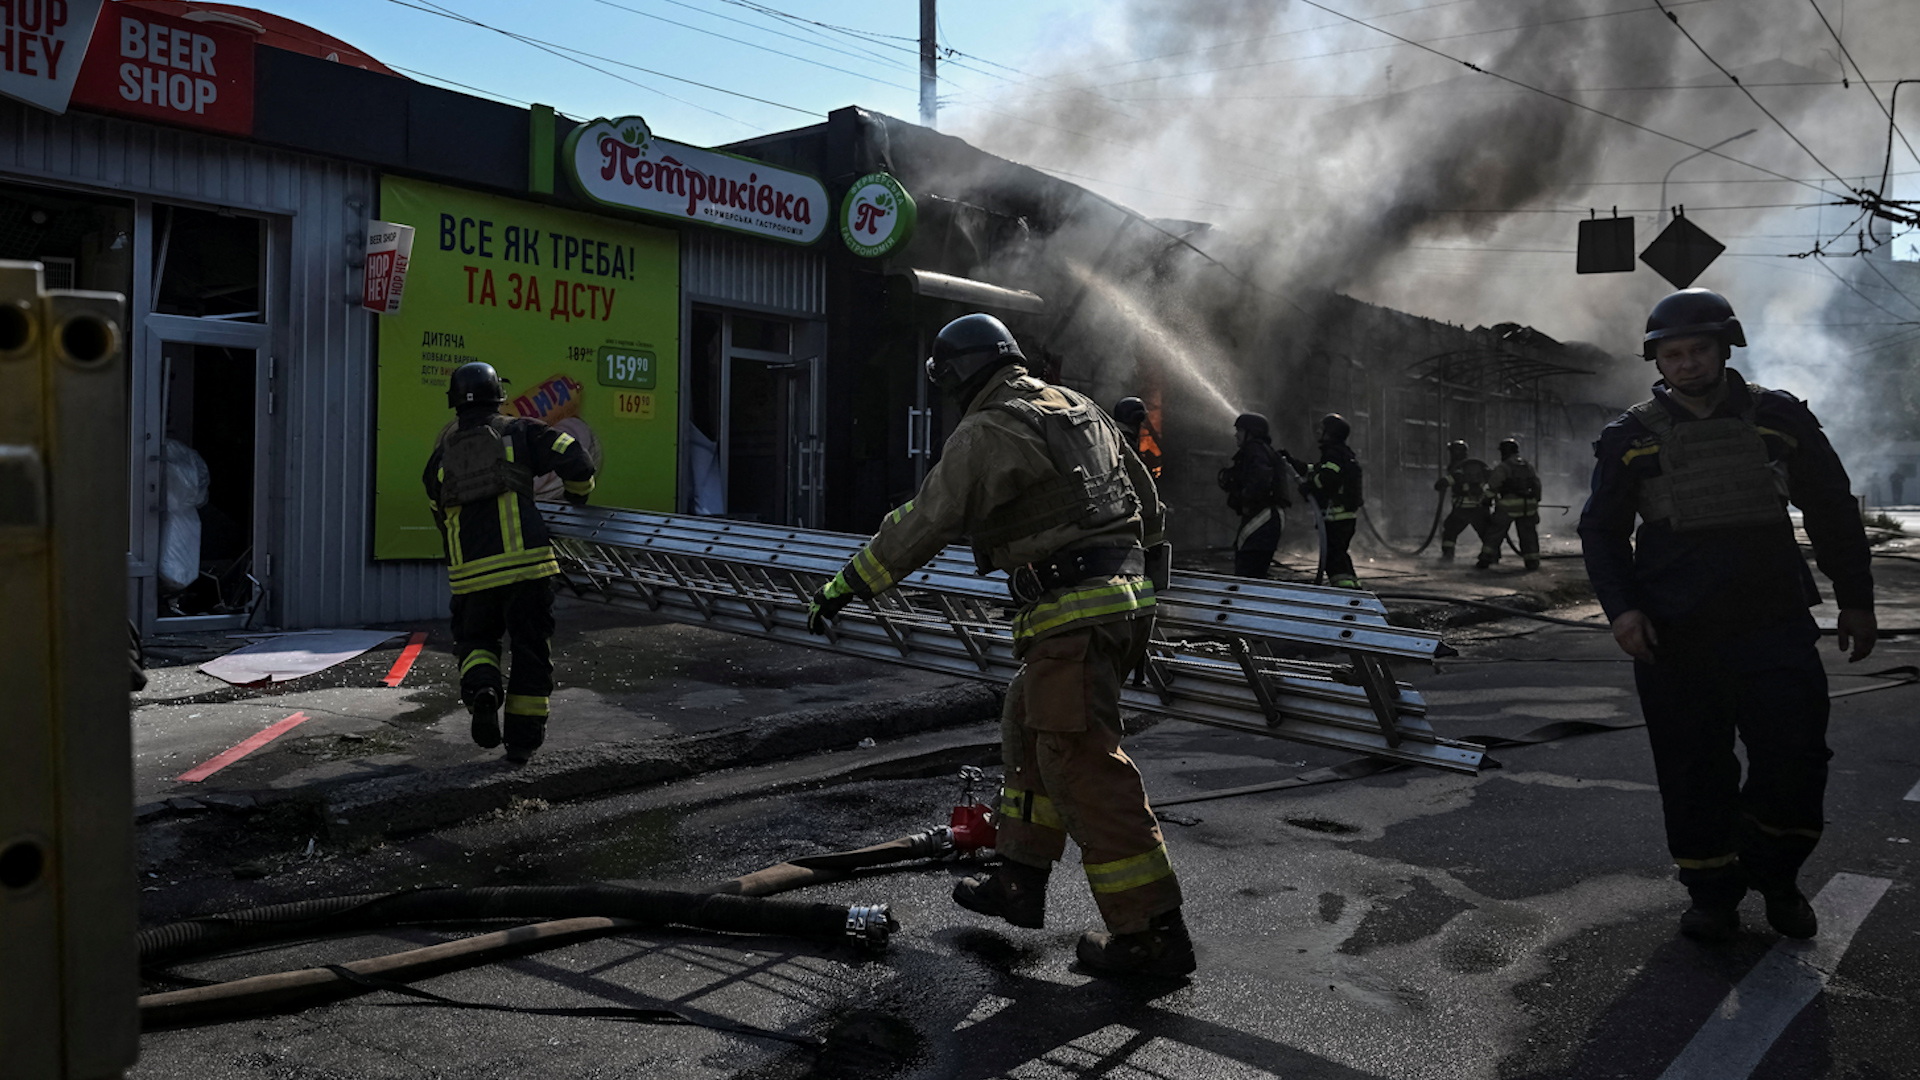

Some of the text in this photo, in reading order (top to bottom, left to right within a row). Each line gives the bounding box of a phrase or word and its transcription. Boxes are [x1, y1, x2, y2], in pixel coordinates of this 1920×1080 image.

[119, 16, 218, 77] BEER
[118, 62, 218, 115] SHOP
[600, 137, 811, 225] Петриківка
[850, 173, 905, 206] ФЕРМЕРСЬКА
[703, 208, 804, 236] ФЕРМЕРСЬКА ГАСТРОНОМІЯ
[370, 232, 397, 245] BEER SHOP
[439, 213, 635, 282] ВСЕ ЯК ТРЕБА!
[842, 225, 896, 256] ГАСТРОНОМІЯ
[368, 254, 389, 278] HOP
[395, 254, 409, 274] HEY
[368, 277, 388, 301] HEY
[391, 276, 404, 296] HOP
[463, 265, 616, 323] ТА ЗА ДСТУ
[422, 331, 464, 348] ДИТЯЧА
[422, 351, 452, 363] КОВБАСА
[422, 365, 439, 376] ДСТУ
